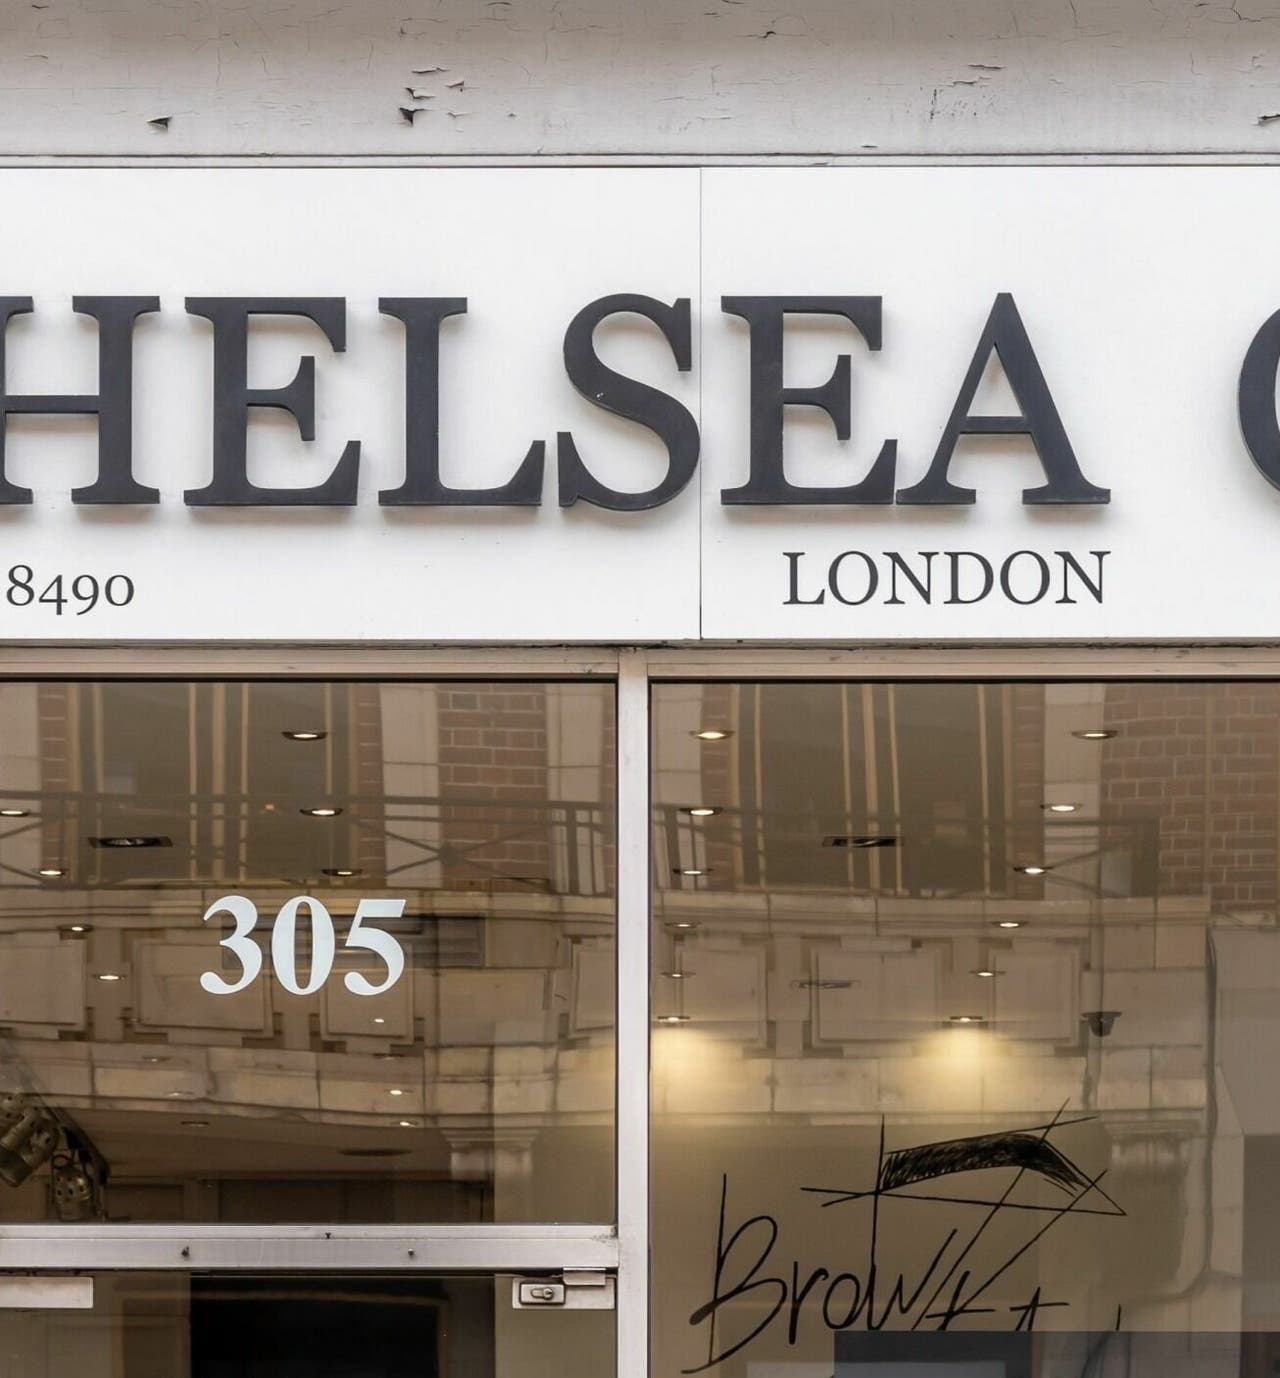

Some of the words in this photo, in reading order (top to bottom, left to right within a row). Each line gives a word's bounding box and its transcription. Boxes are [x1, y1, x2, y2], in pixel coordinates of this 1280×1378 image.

[7, 565, 134, 615] 8490
[783, 551, 1111, 605] LONDON
[200, 895, 406, 995] 305
